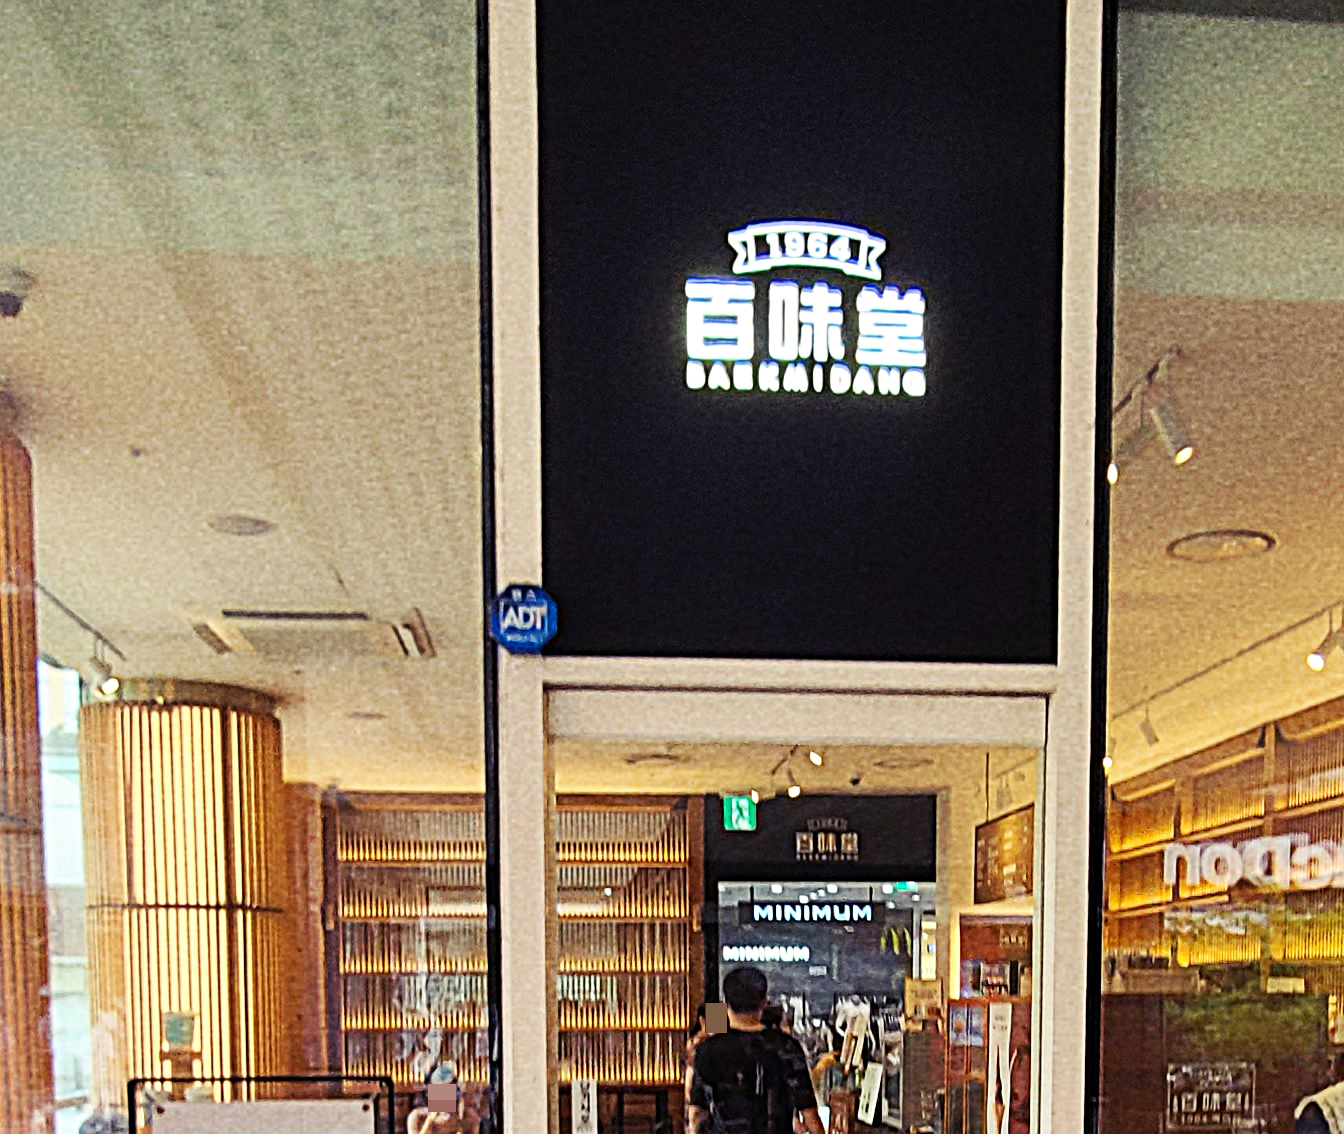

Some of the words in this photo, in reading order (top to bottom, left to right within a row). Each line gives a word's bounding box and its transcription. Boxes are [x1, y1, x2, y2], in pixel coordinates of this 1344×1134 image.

[765, 231, 852, 262] 1964
[685, 277, 927, 368] 百味堂
[686, 359, 927, 398] BAEKMIDANG
[504, 606, 547, 630] ADT
[753, 904, 872, 921] MINIMUM
[723, 946, 810, 962] MINIMUM
